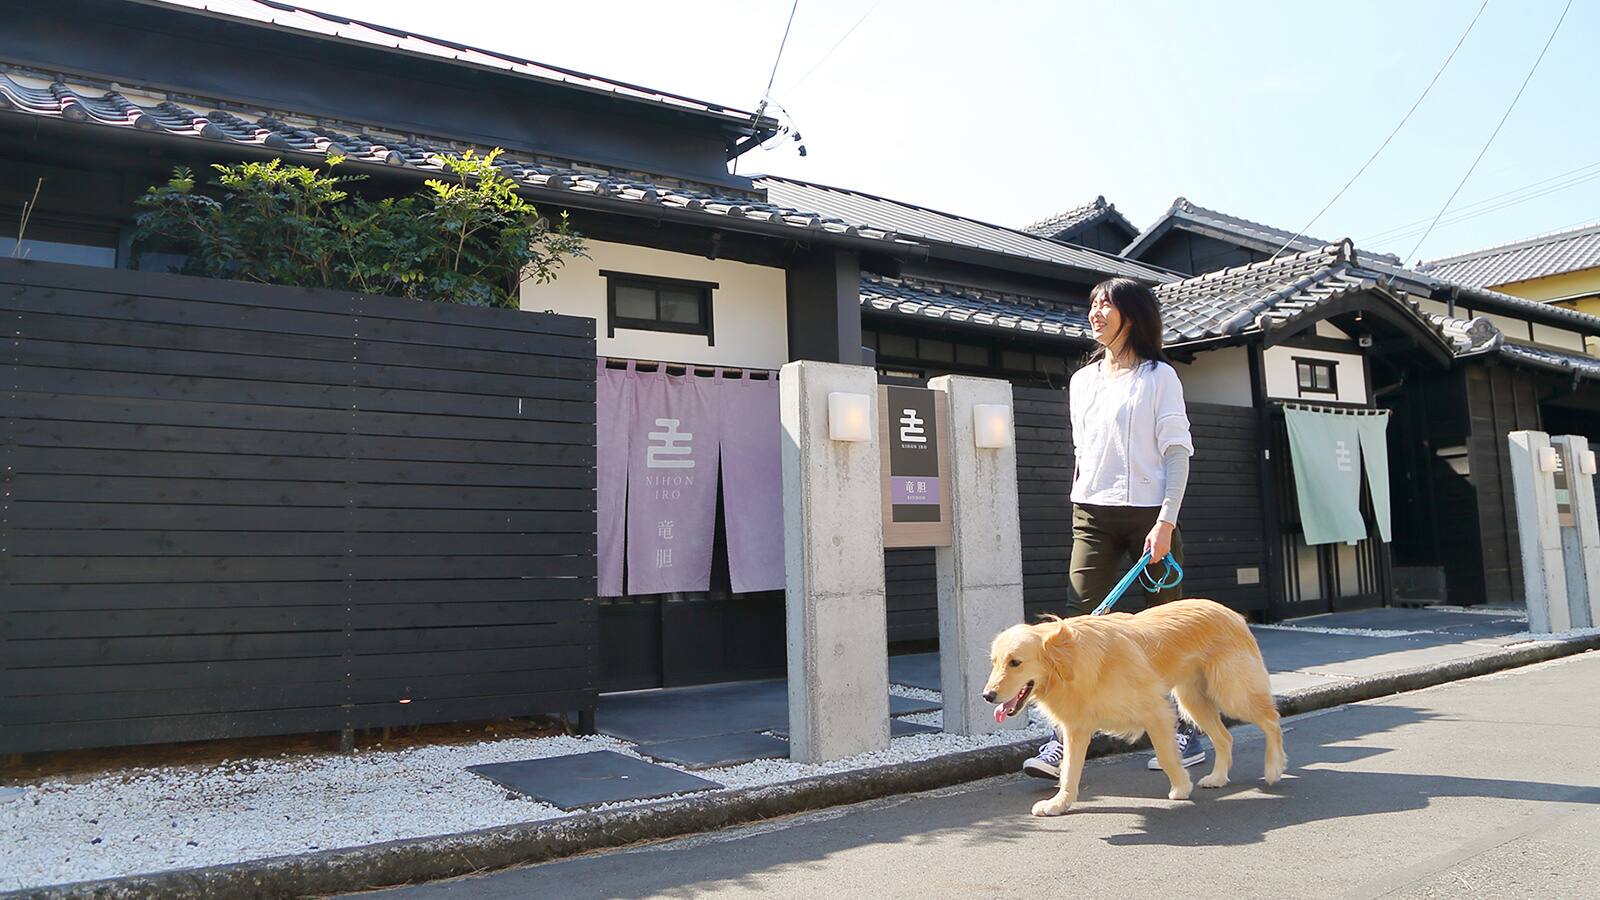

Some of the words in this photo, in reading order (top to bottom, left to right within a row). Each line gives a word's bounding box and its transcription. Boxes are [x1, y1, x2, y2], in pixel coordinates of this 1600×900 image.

[646, 475, 694, 486] NIHON
[905, 480, 927, 493] 竜胆
[655, 490, 681, 500] IRO
[656, 519, 674, 568] 竜胆
